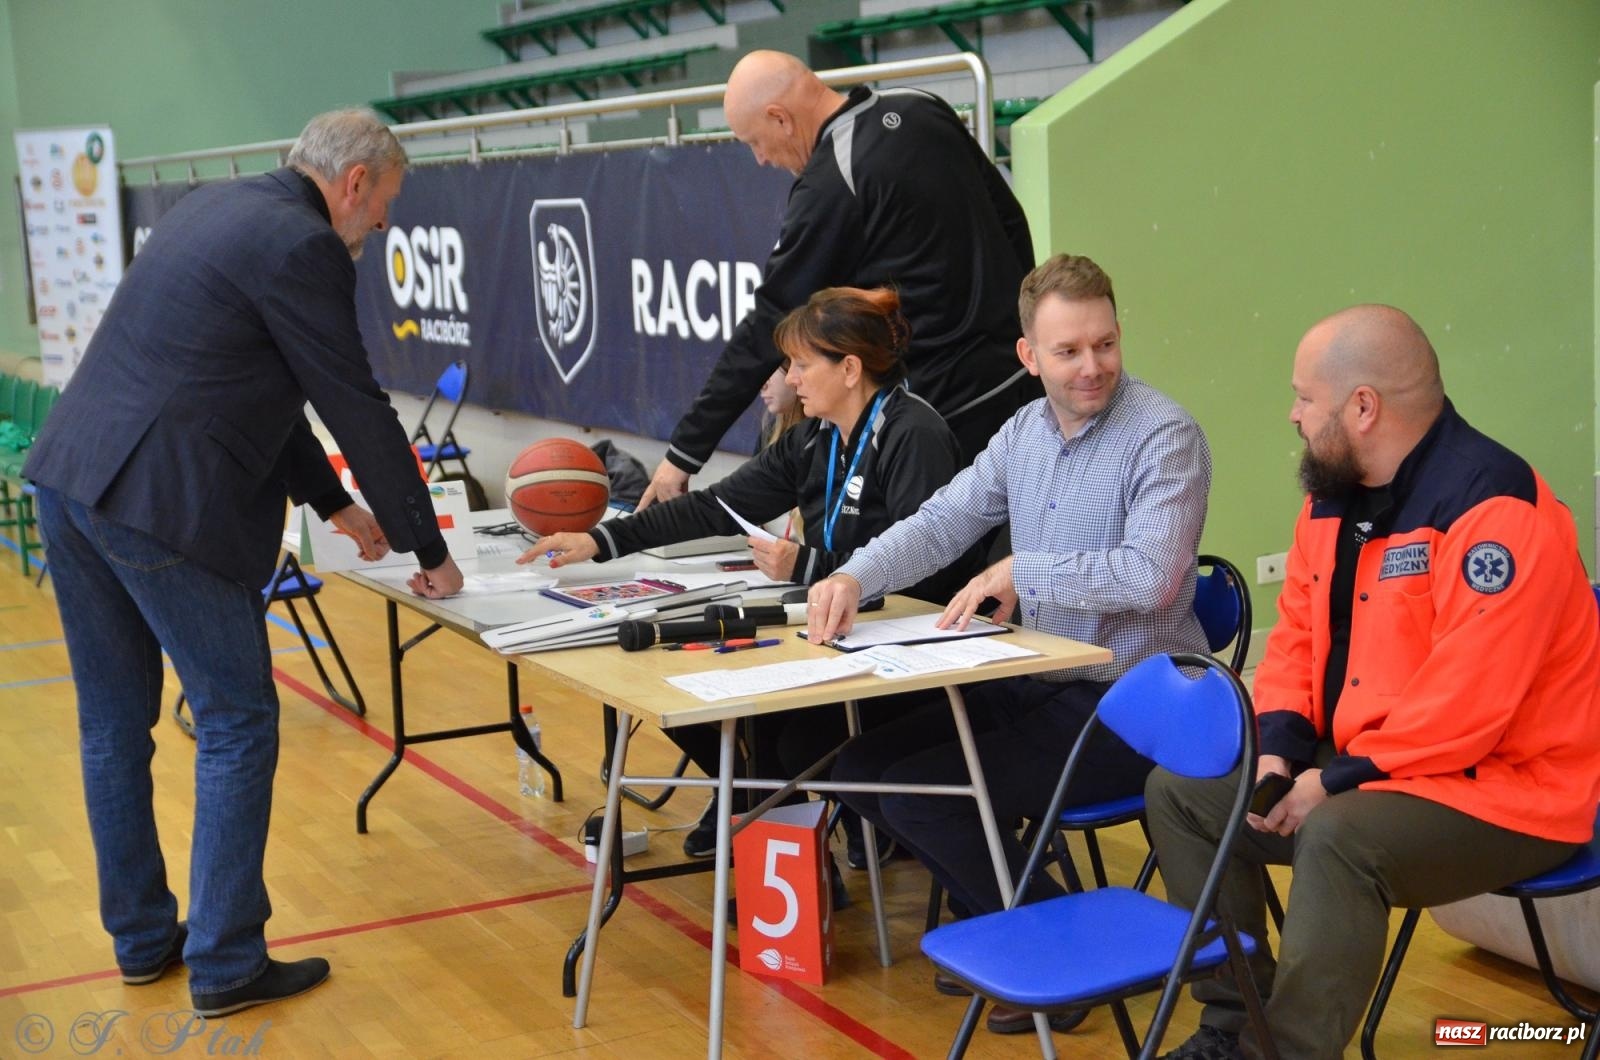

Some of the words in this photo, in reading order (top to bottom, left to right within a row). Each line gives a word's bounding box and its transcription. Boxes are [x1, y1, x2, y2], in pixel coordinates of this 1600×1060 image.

[386, 225, 468, 314] OSiR
[420, 313, 471, 347] RACIBÓRZ
[752, 838, 800, 938] 5
